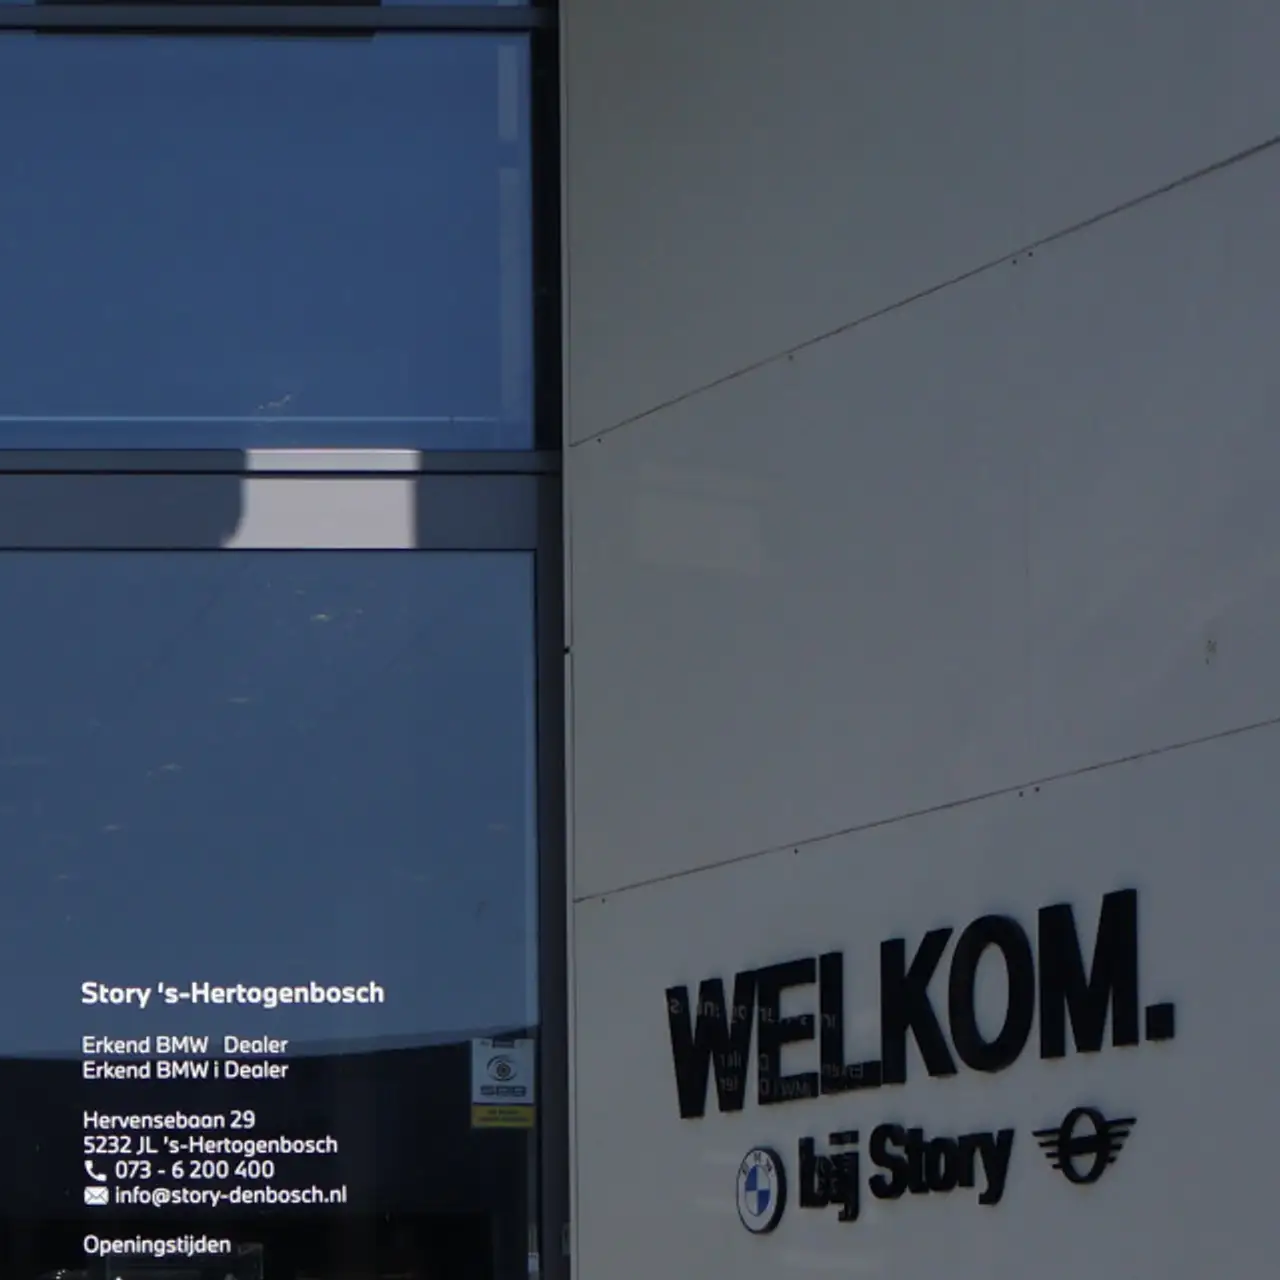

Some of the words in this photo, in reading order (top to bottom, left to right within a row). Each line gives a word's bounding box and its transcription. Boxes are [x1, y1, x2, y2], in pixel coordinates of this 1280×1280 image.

[81, 981, 151, 1008] Story
[157, 981, 385, 1008] 's-Hertogenbosch
[665, 888, 1175, 1118] WELKOM.
[82, 1035, 150, 1054] Erkend
[156, 1035, 209, 1054] BMW
[224, 1035, 289, 1054] Dealer
[83, 1060, 151, 1079] Erkend
[156, 1060, 209, 1079] BMW
[213, 1060, 219, 1079] i
[224, 1060, 289, 1079] Dealer
[83, 1110, 226, 1130] Hervensebaan
[230, 1110, 256, 1130] 29
[83, 1135, 132, 1154] 5232
[135, 1135, 158, 1156] JL
[163, 1135, 338, 1157] 's-Hertogenbosch
[115, 1160, 152, 1179] 073
[171, 1160, 185, 1179] 6
[189, 1160, 229, 1179] 200
[234, 1160, 275, 1179] 400
[869, 1123, 1015, 1205] Story
[115, 1184, 347, 1207] info@story-denbosch.nl
[83, 1234, 232, 1258] Openingstijden
